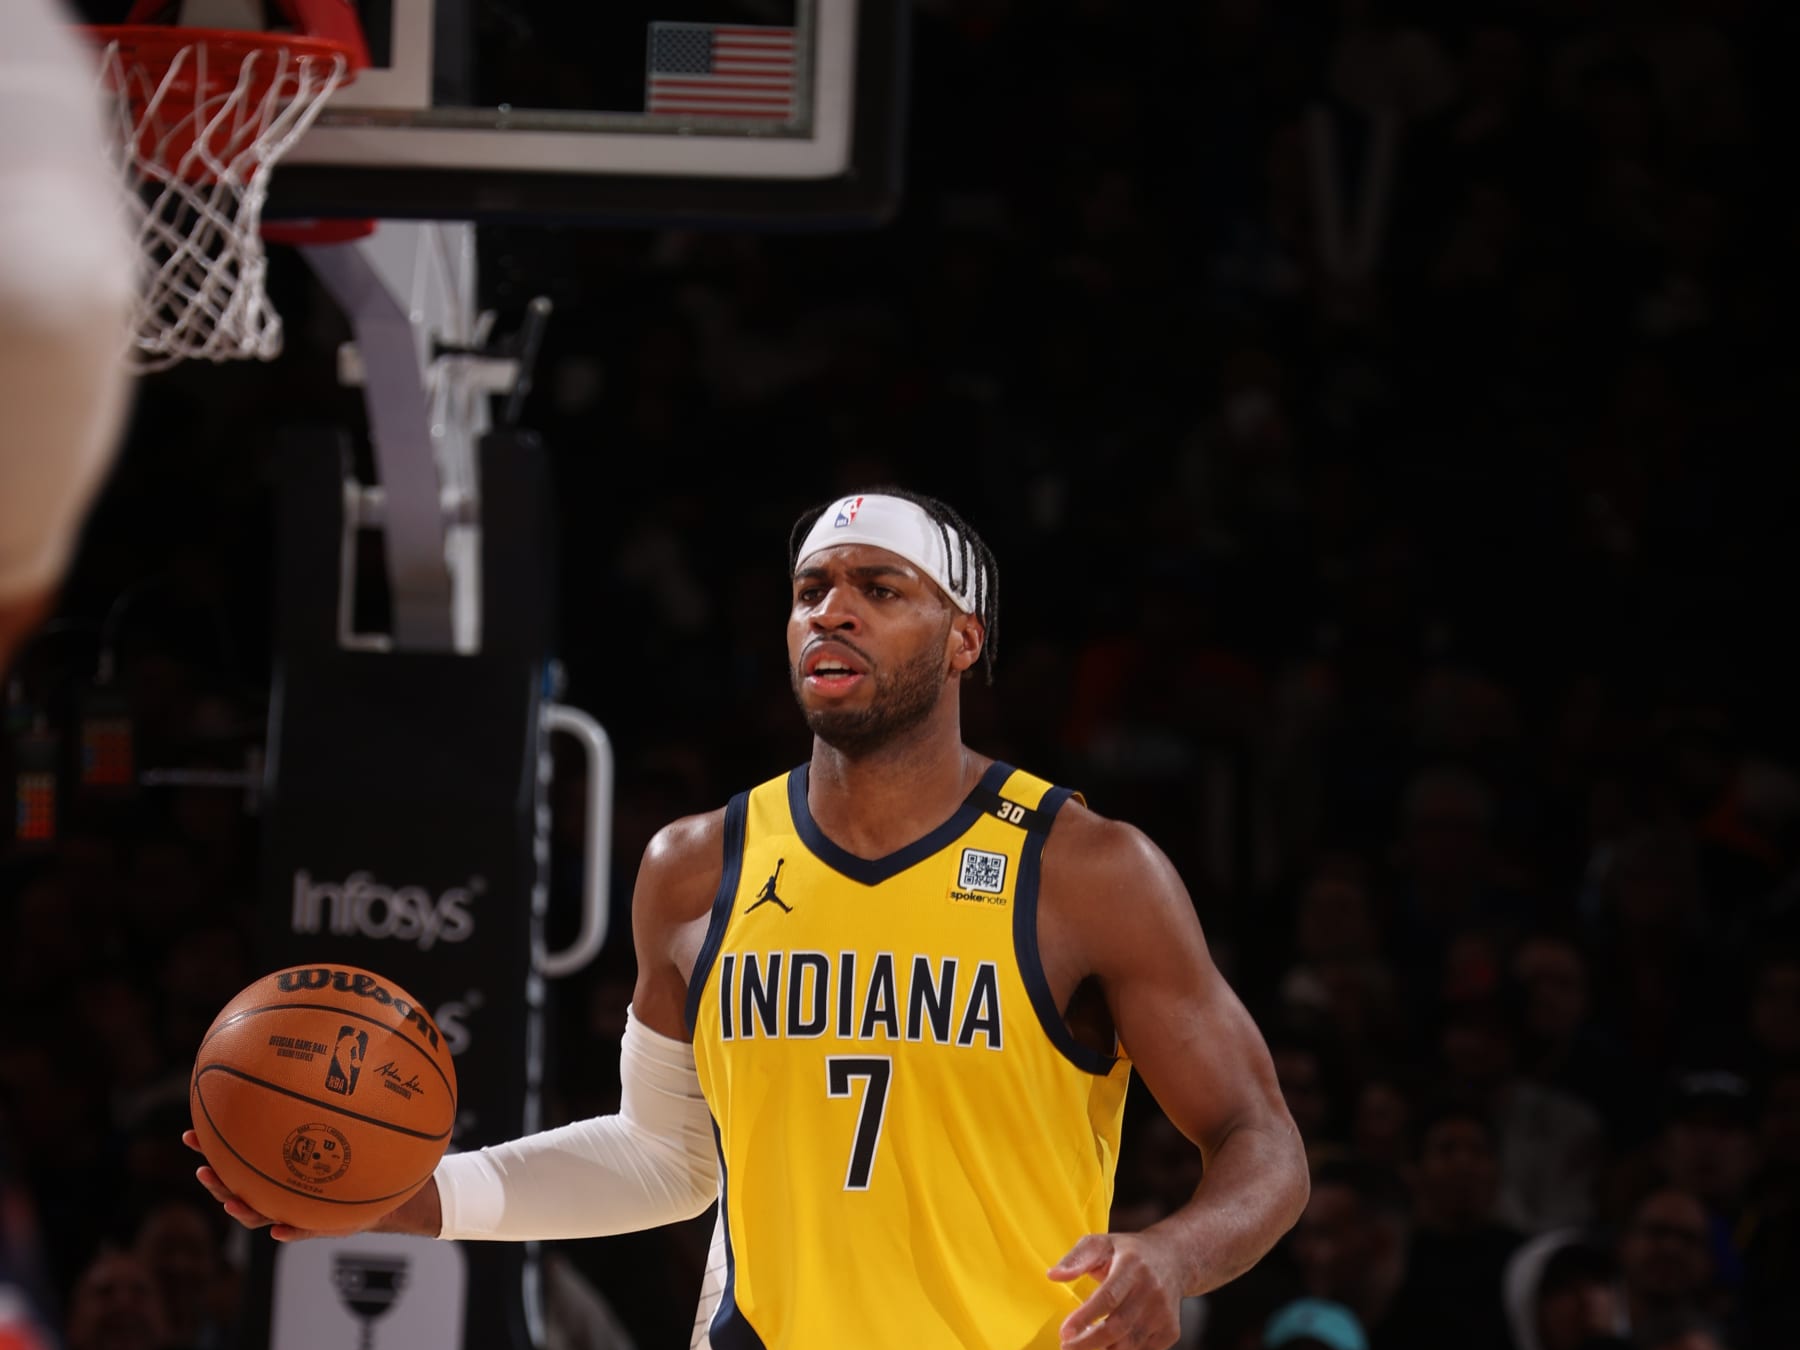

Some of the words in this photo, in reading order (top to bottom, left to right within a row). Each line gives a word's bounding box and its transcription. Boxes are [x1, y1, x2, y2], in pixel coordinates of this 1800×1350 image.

[997, 801, 1025, 824] 30
[291, 868, 474, 950] Infosys
[950, 891, 1006, 905] spokenote
[277, 968, 439, 1053] Wilson
[720, 950, 1004, 1051] INDIANA
[312, 1042, 328, 1055] BALL
[327, 1075, 345, 1091] NBA
[825, 1054, 893, 1191] 7
